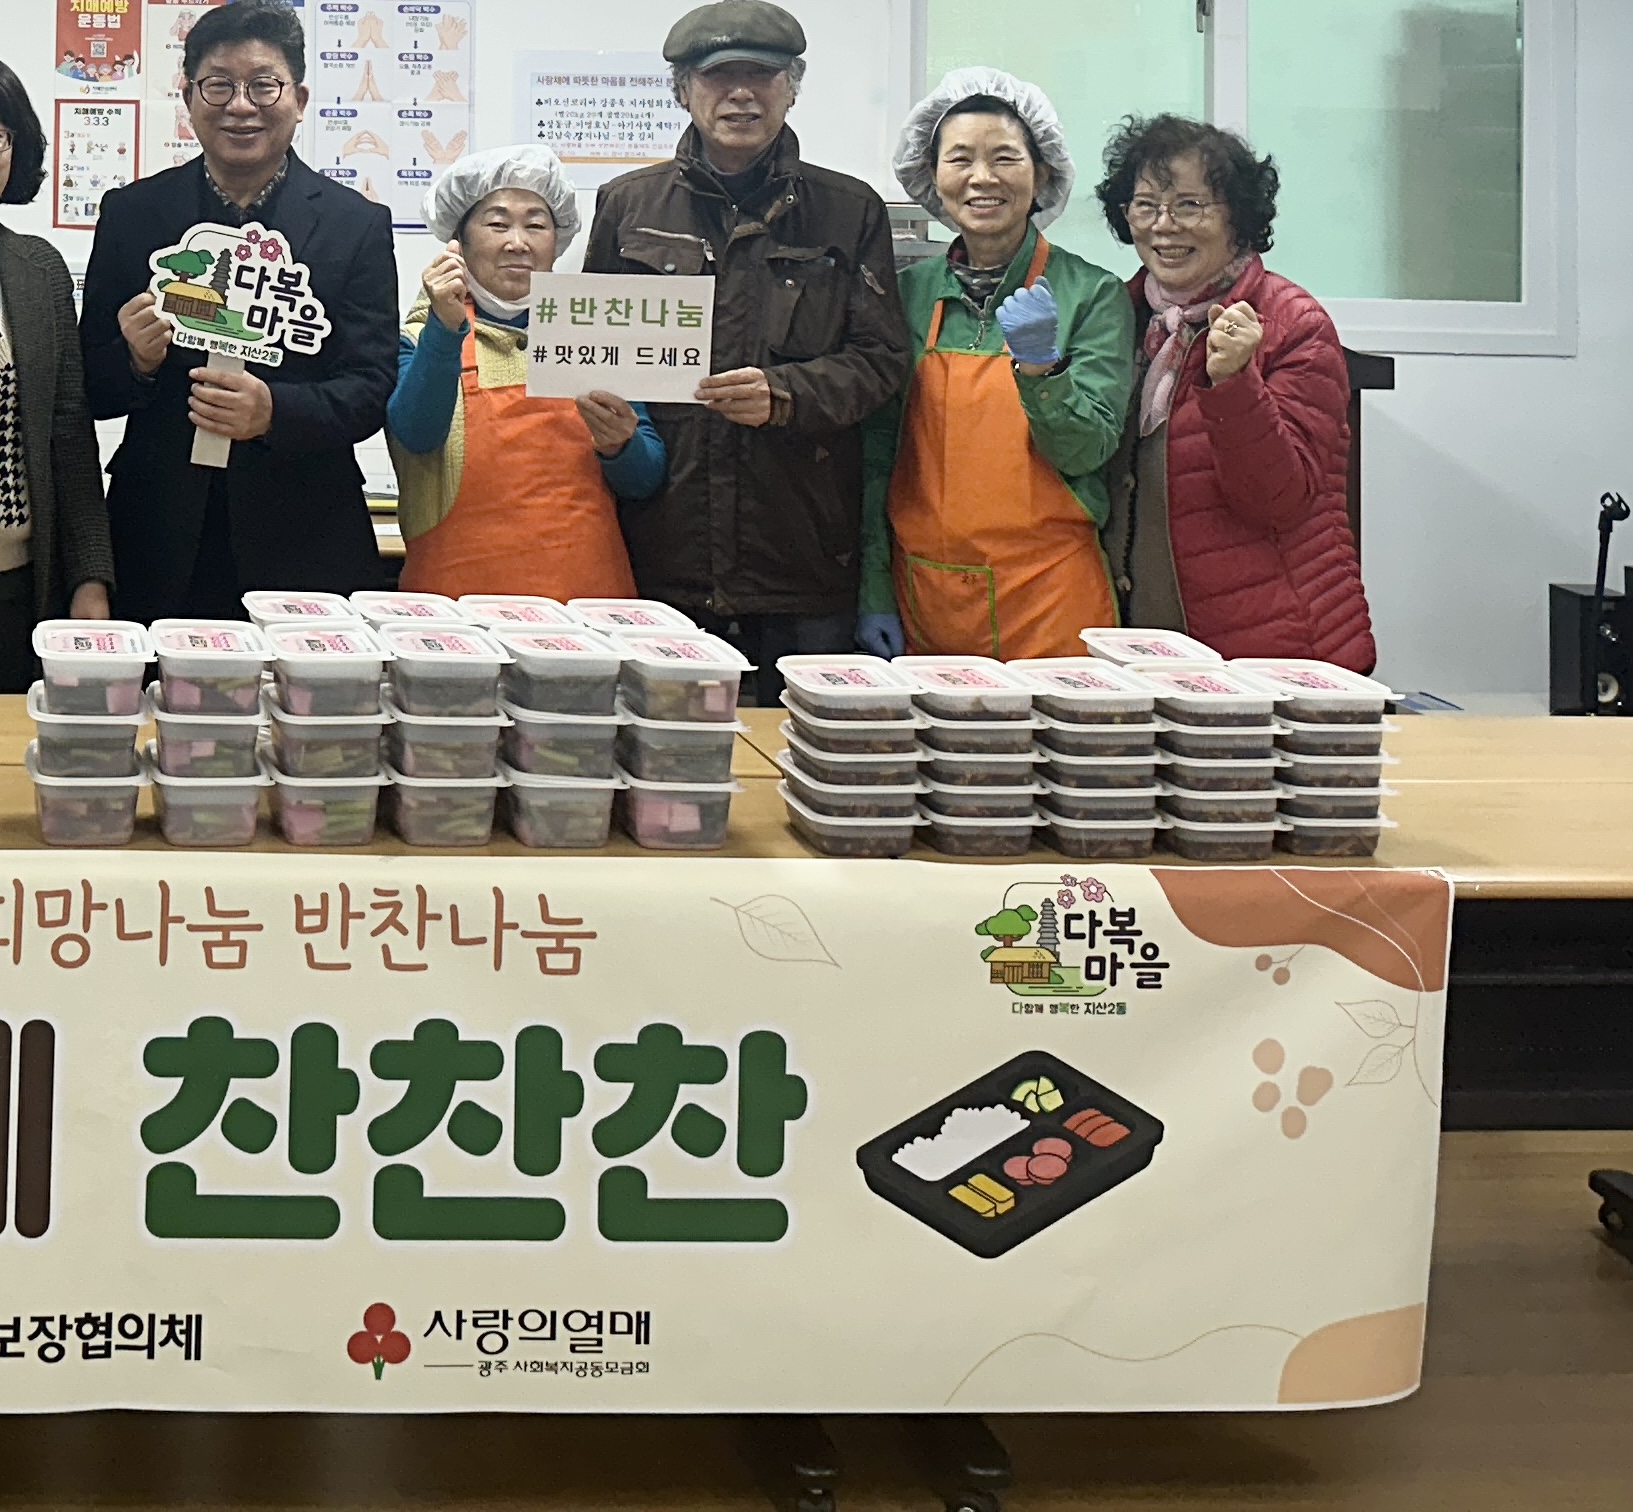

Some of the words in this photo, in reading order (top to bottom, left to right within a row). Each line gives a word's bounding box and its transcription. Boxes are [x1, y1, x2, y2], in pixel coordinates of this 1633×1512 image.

[77, 13, 121, 28] 운동법
[536, 75, 571, 86] 사랑채에
[573, 76, 599, 87] 따뜻한
[601, 76, 626, 87] 마음을
[629, 76, 663, 87] 전해주신
[234, 264, 306, 313] 다복
[246, 304, 325, 348] 마을
[535, 297, 704, 328] #반찬나눔
[175, 331, 206, 347] 다함께
[209, 339, 237, 354] 행복한
[240, 345, 280, 364] 지산2동
[532, 345, 619, 366] #맛있게
[635, 346, 701, 367] 드세요
[292, 882, 599, 976] 반찬나눔
[1063, 906, 1143, 955] 다복
[1084, 942, 1171, 990] 마을
[1011, 1002, 1044, 1015] 다함께
[1049, 1002, 1080, 1015] 행복한
[1084, 1002, 1127, 1016] 지산2동
[139, 1014, 810, 1242] 찬찬찬
[423, 1308, 651, 1355] 사랑의열매
[477, 1360, 509, 1378] 광주
[512, 1360, 650, 1378] 사회복지공동모금회
